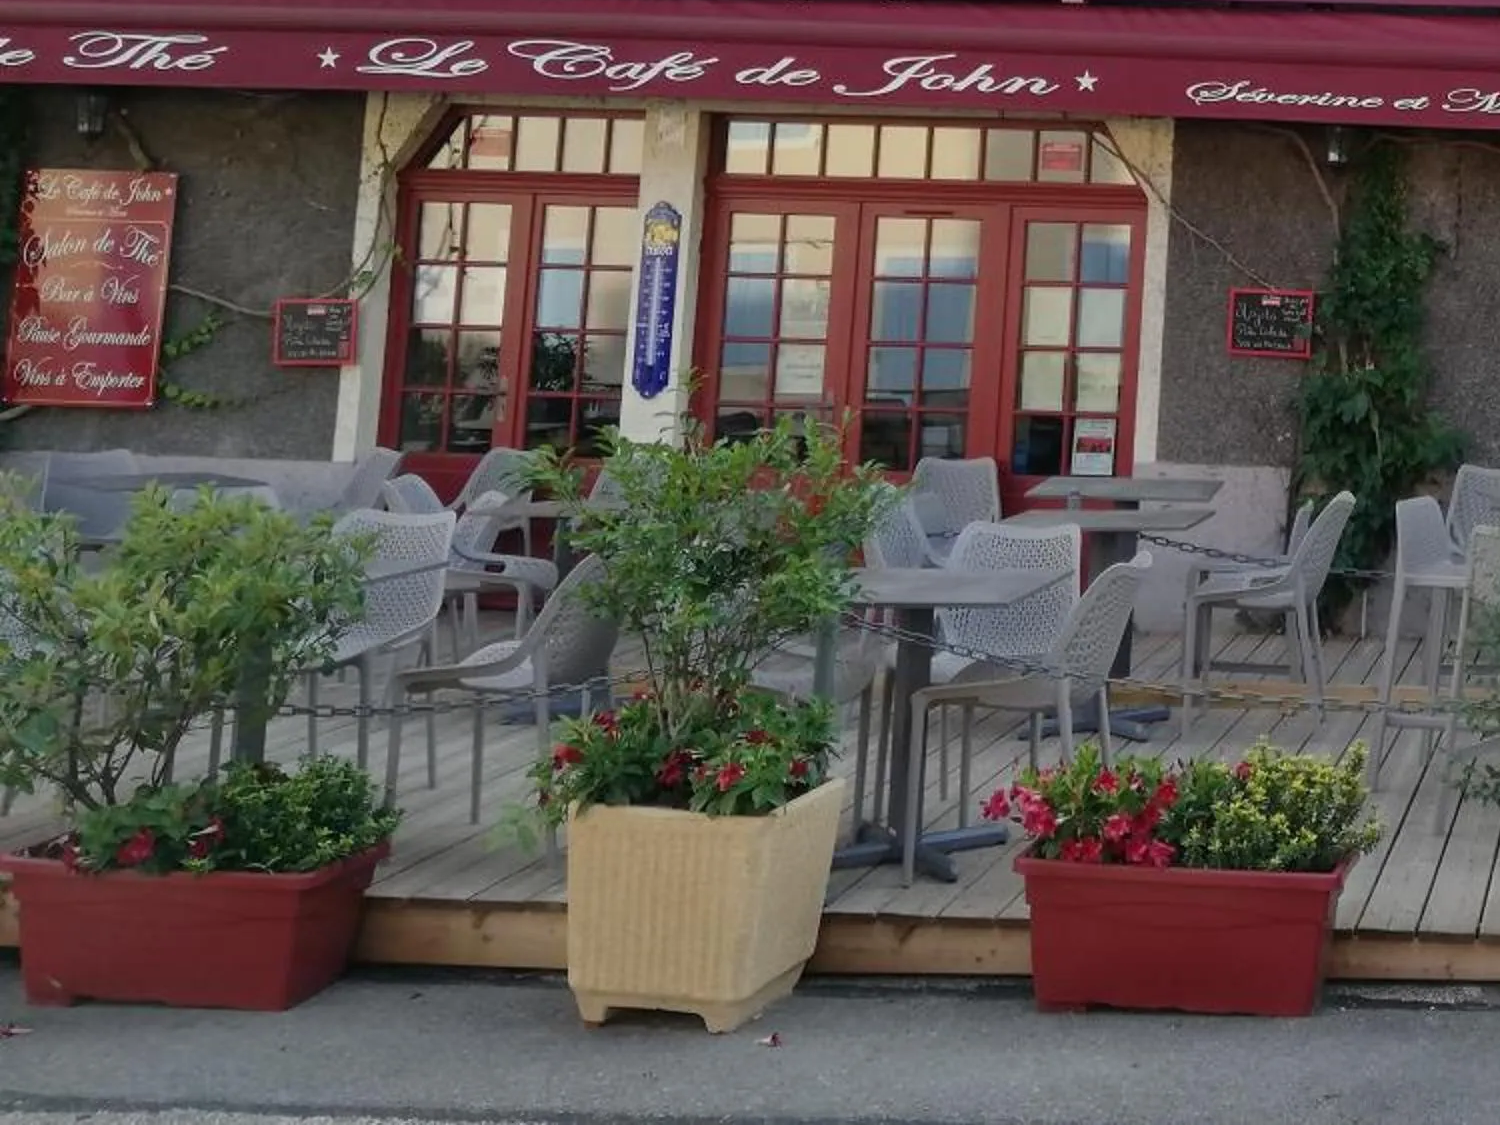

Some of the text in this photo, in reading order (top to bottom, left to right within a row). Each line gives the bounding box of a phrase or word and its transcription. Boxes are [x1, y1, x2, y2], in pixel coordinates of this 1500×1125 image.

[63, 31, 228, 71] Thé
[356, 38, 1060, 97] Le Café de John
[1186, 80, 1385, 110] Séverine
[1393, 96, 1430, 111] et
[38, 175, 163, 206] Le Café de John
[23, 226, 164, 267] Salon de Thé
[41, 277, 81, 303] Bar
[101, 275, 141, 305] Vins
[17, 315, 151, 351] Pause Gourmande
[14, 357, 54, 387] Vins
[72, 361, 146, 396] Emporter
